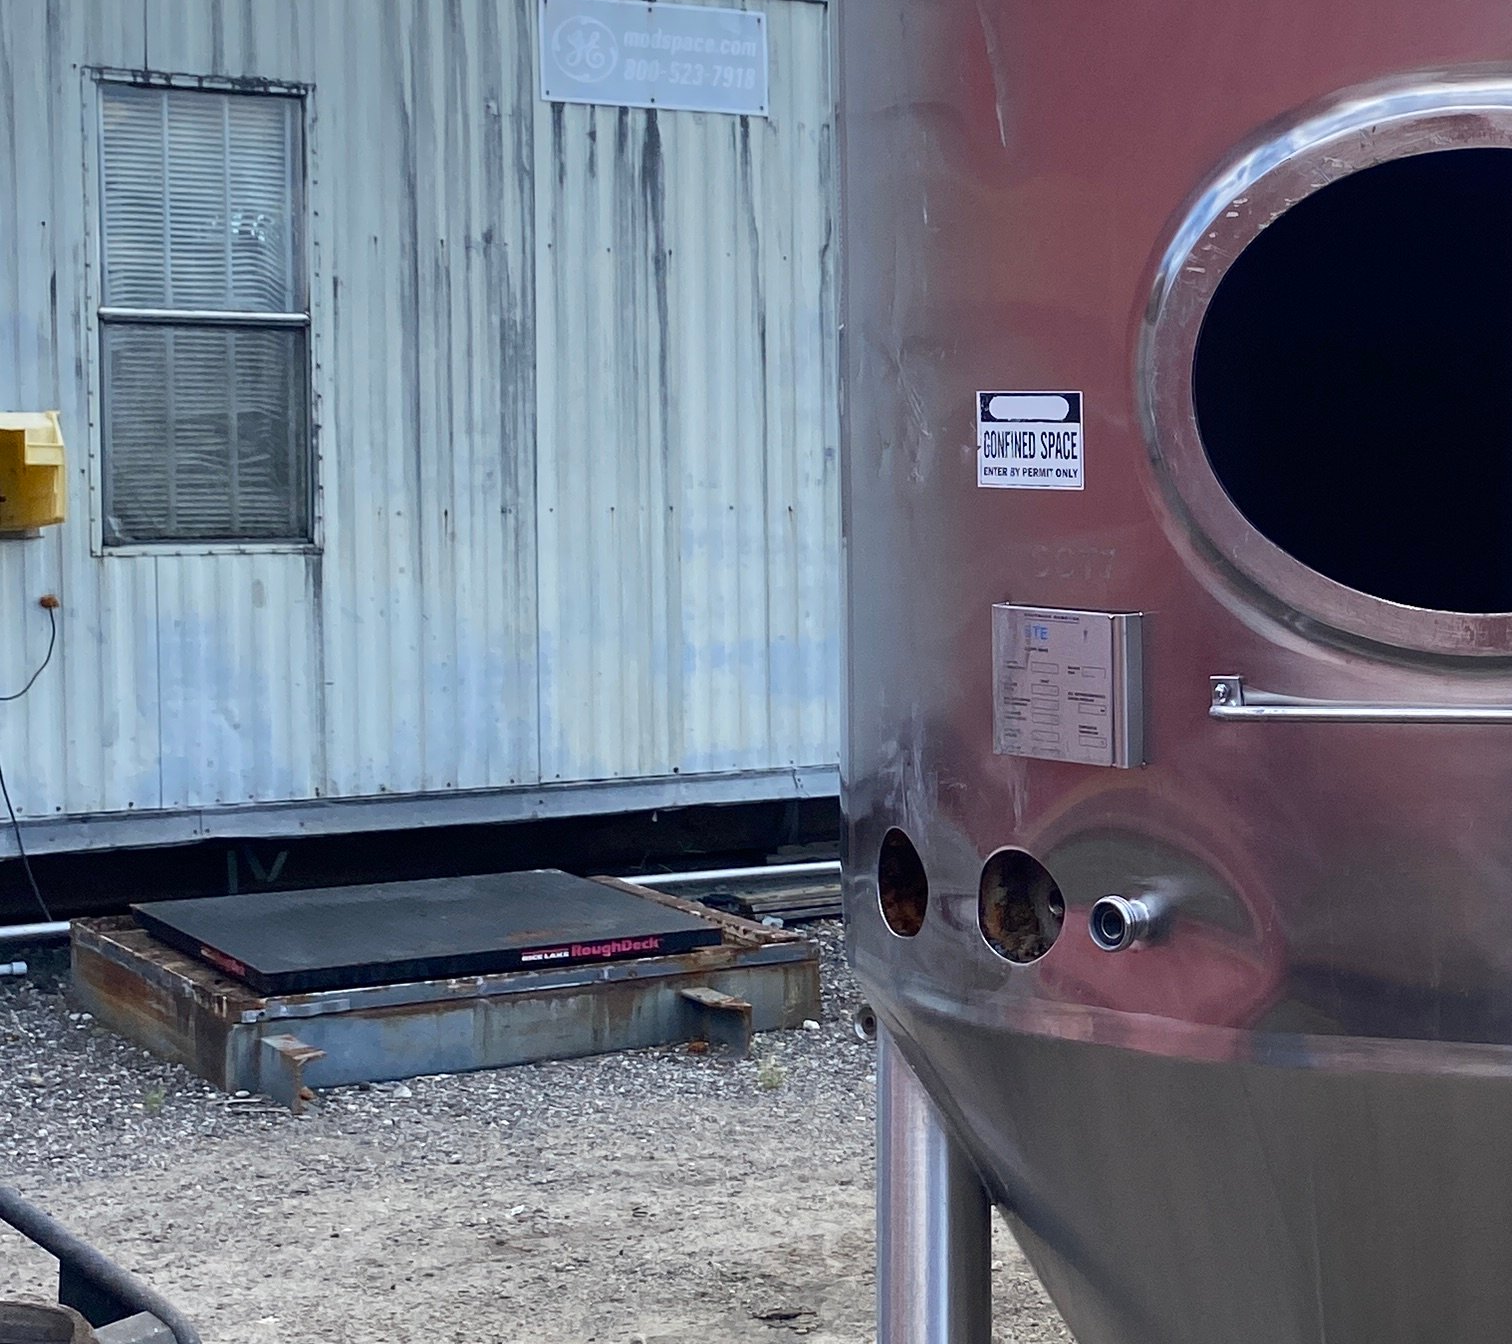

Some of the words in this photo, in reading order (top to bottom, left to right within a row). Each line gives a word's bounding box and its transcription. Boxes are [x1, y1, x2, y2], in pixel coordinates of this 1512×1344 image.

[623, 29, 757, 57] modspace.com
[623, 58, 756, 90] 800-523-7918
[1040, 431, 1078, 460] SPACE
[983, 467, 1008, 477] ENTER
[1010, 467, 1020, 477] BY
[1022, 468, 1054, 478] PERMIT
[1055, 468, 1078, 479] ONLY
[571, 938, 660, 957] RoughDeck
